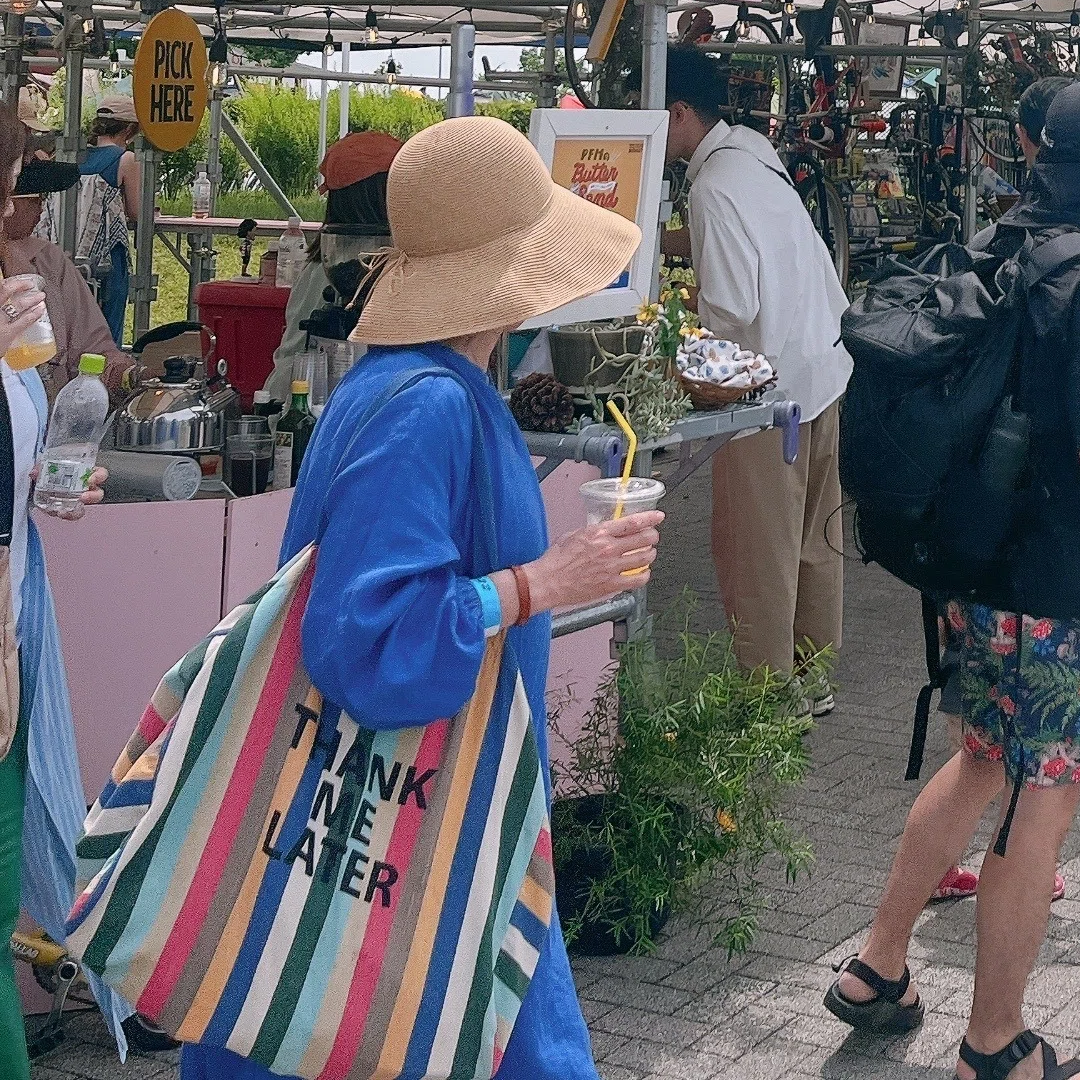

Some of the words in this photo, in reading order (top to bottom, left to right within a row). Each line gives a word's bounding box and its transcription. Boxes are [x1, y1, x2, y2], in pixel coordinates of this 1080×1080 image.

[153, 39, 194, 80] PICK
[149, 84, 195, 123] HERE
[291, 702, 439, 810] THANK
[310, 780, 377, 847] ME
[262, 809, 399, 908] LATER
